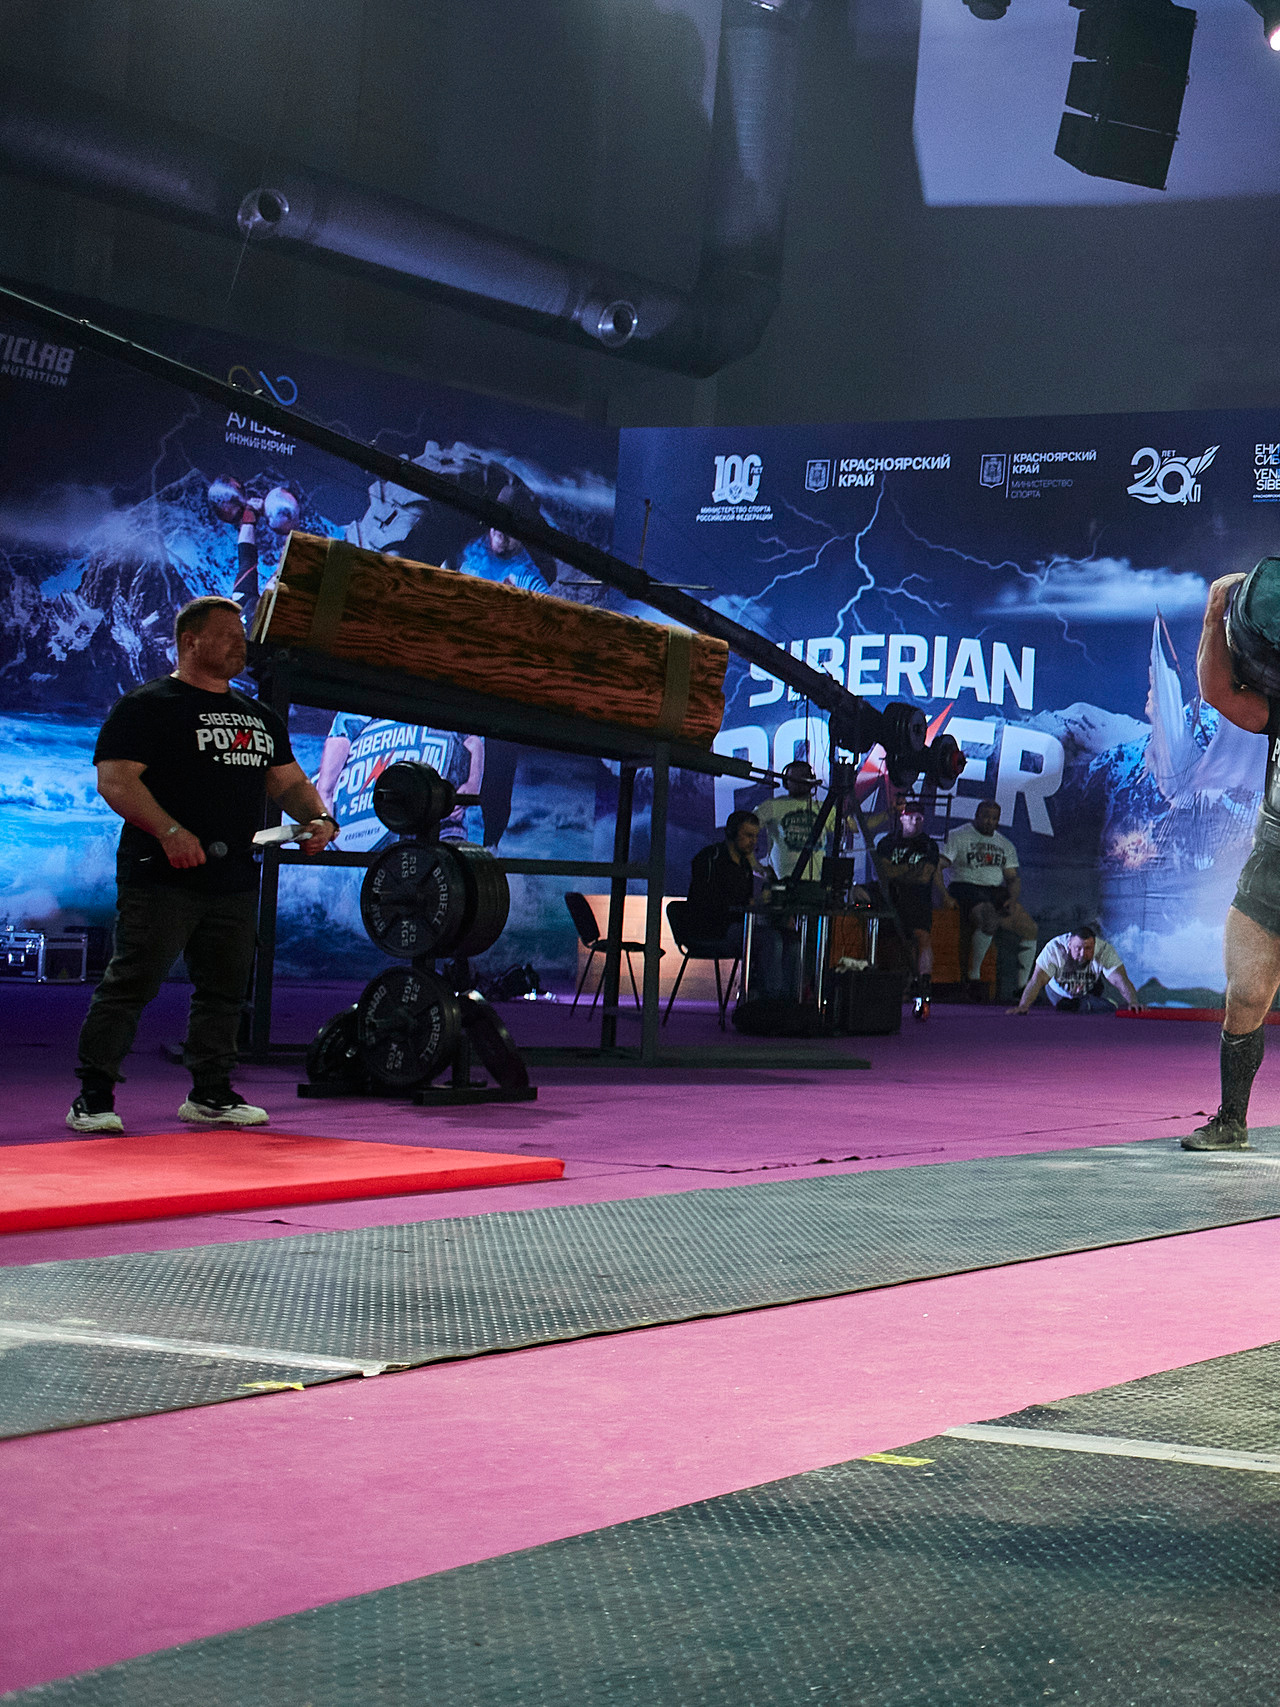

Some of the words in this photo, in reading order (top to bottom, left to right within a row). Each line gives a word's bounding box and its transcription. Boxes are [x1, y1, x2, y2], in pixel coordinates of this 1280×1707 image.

[0, 363, 68, 386] NUTRITION
[1013, 449, 1097, 463] КРАСНОЯРСКИЙ
[1161, 449, 1177, 458] ЛЕТ
[839, 453, 951, 472] КРАСНОЯРСКИЙ
[1012, 462, 1040, 475] КРАЙ
[838, 471, 875, 488] КРАЙ
[1011, 479, 1074, 489] МИНИСТЕРСТВО
[1010, 489, 1041, 499] СПОРТА
[199, 713, 267, 731] SIBERIAN
[196, 727, 275, 759] POWER
[347, 725, 418, 763] SIBERIAN
[223, 752, 262, 767] SHOW
[432, 866, 449, 927] BARBELL
[419, 1006, 441, 1062] BARBELL
